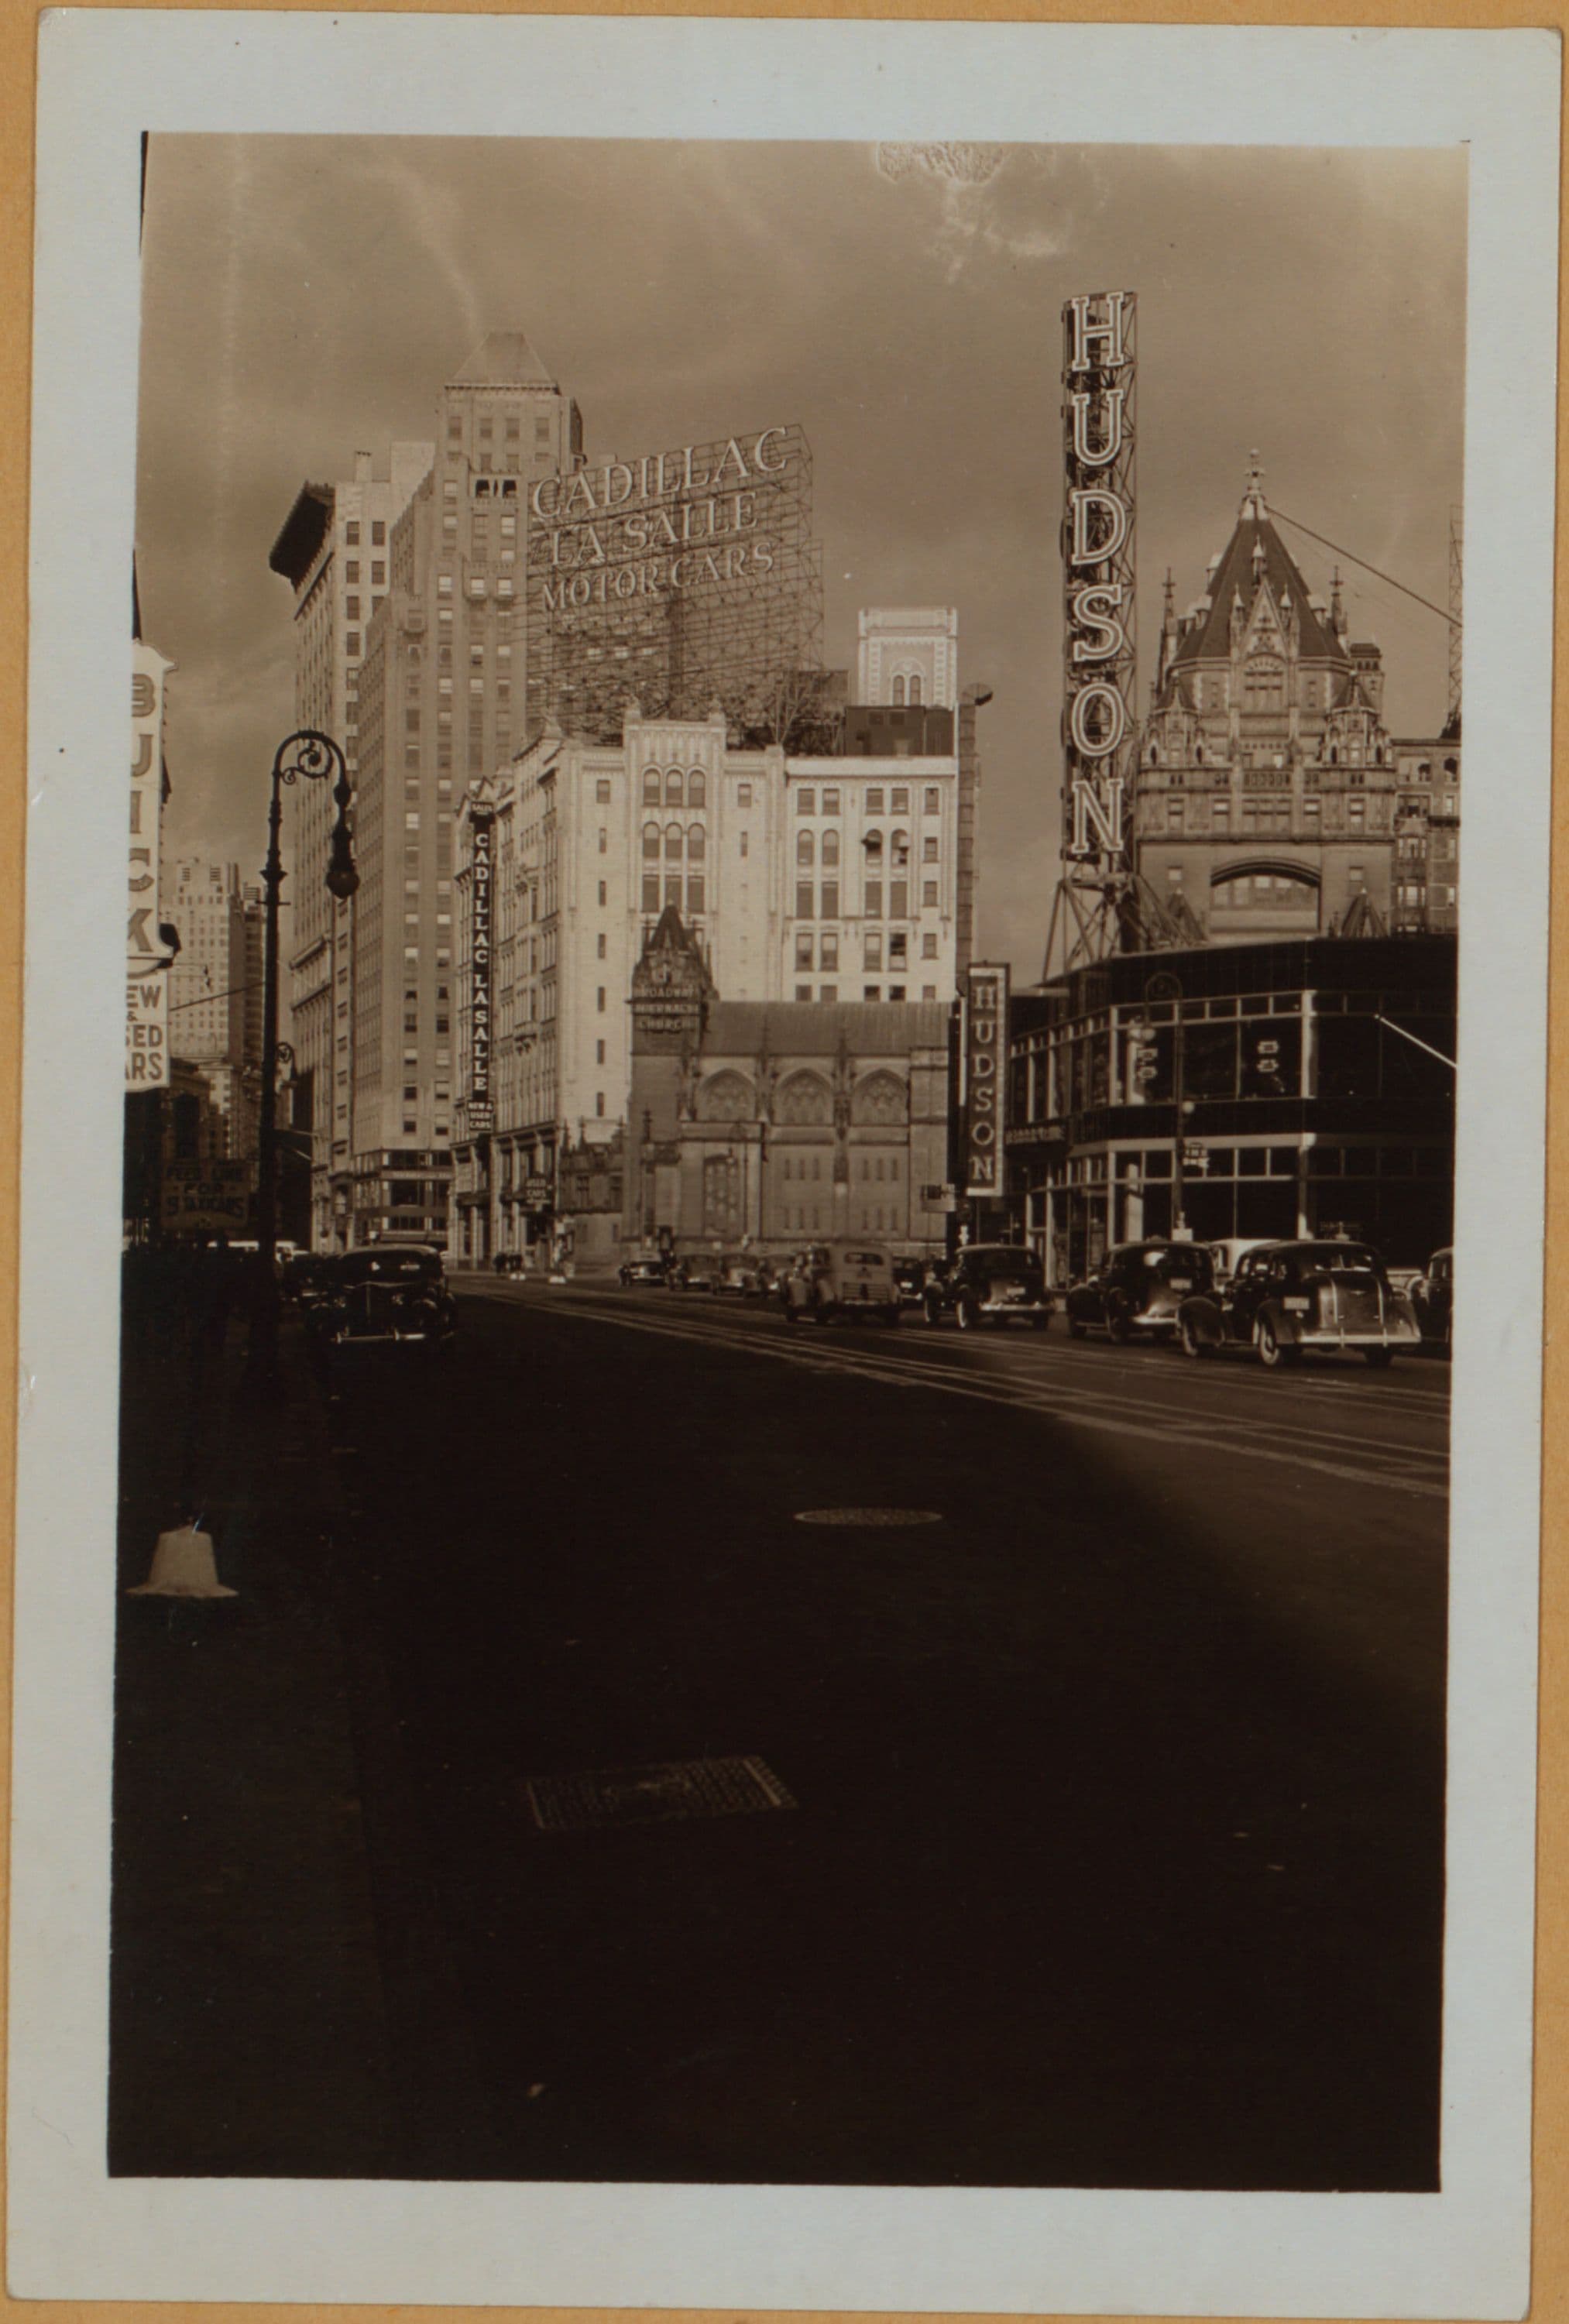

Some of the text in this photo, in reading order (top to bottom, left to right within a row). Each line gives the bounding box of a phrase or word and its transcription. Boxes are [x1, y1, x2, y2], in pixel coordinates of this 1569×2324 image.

[533, 427, 787, 518] CADILLAC
[551, 492, 757, 567] LA SALLE
[1070, 291, 1125, 853] HUDSON
[544, 542, 774, 612] MOTOR CARS
[473, 833, 490, 1090] CADILLAC LA SALLE
[125, 1052, 163, 1080] RS
[971, 985, 996, 1180] HUDSON
